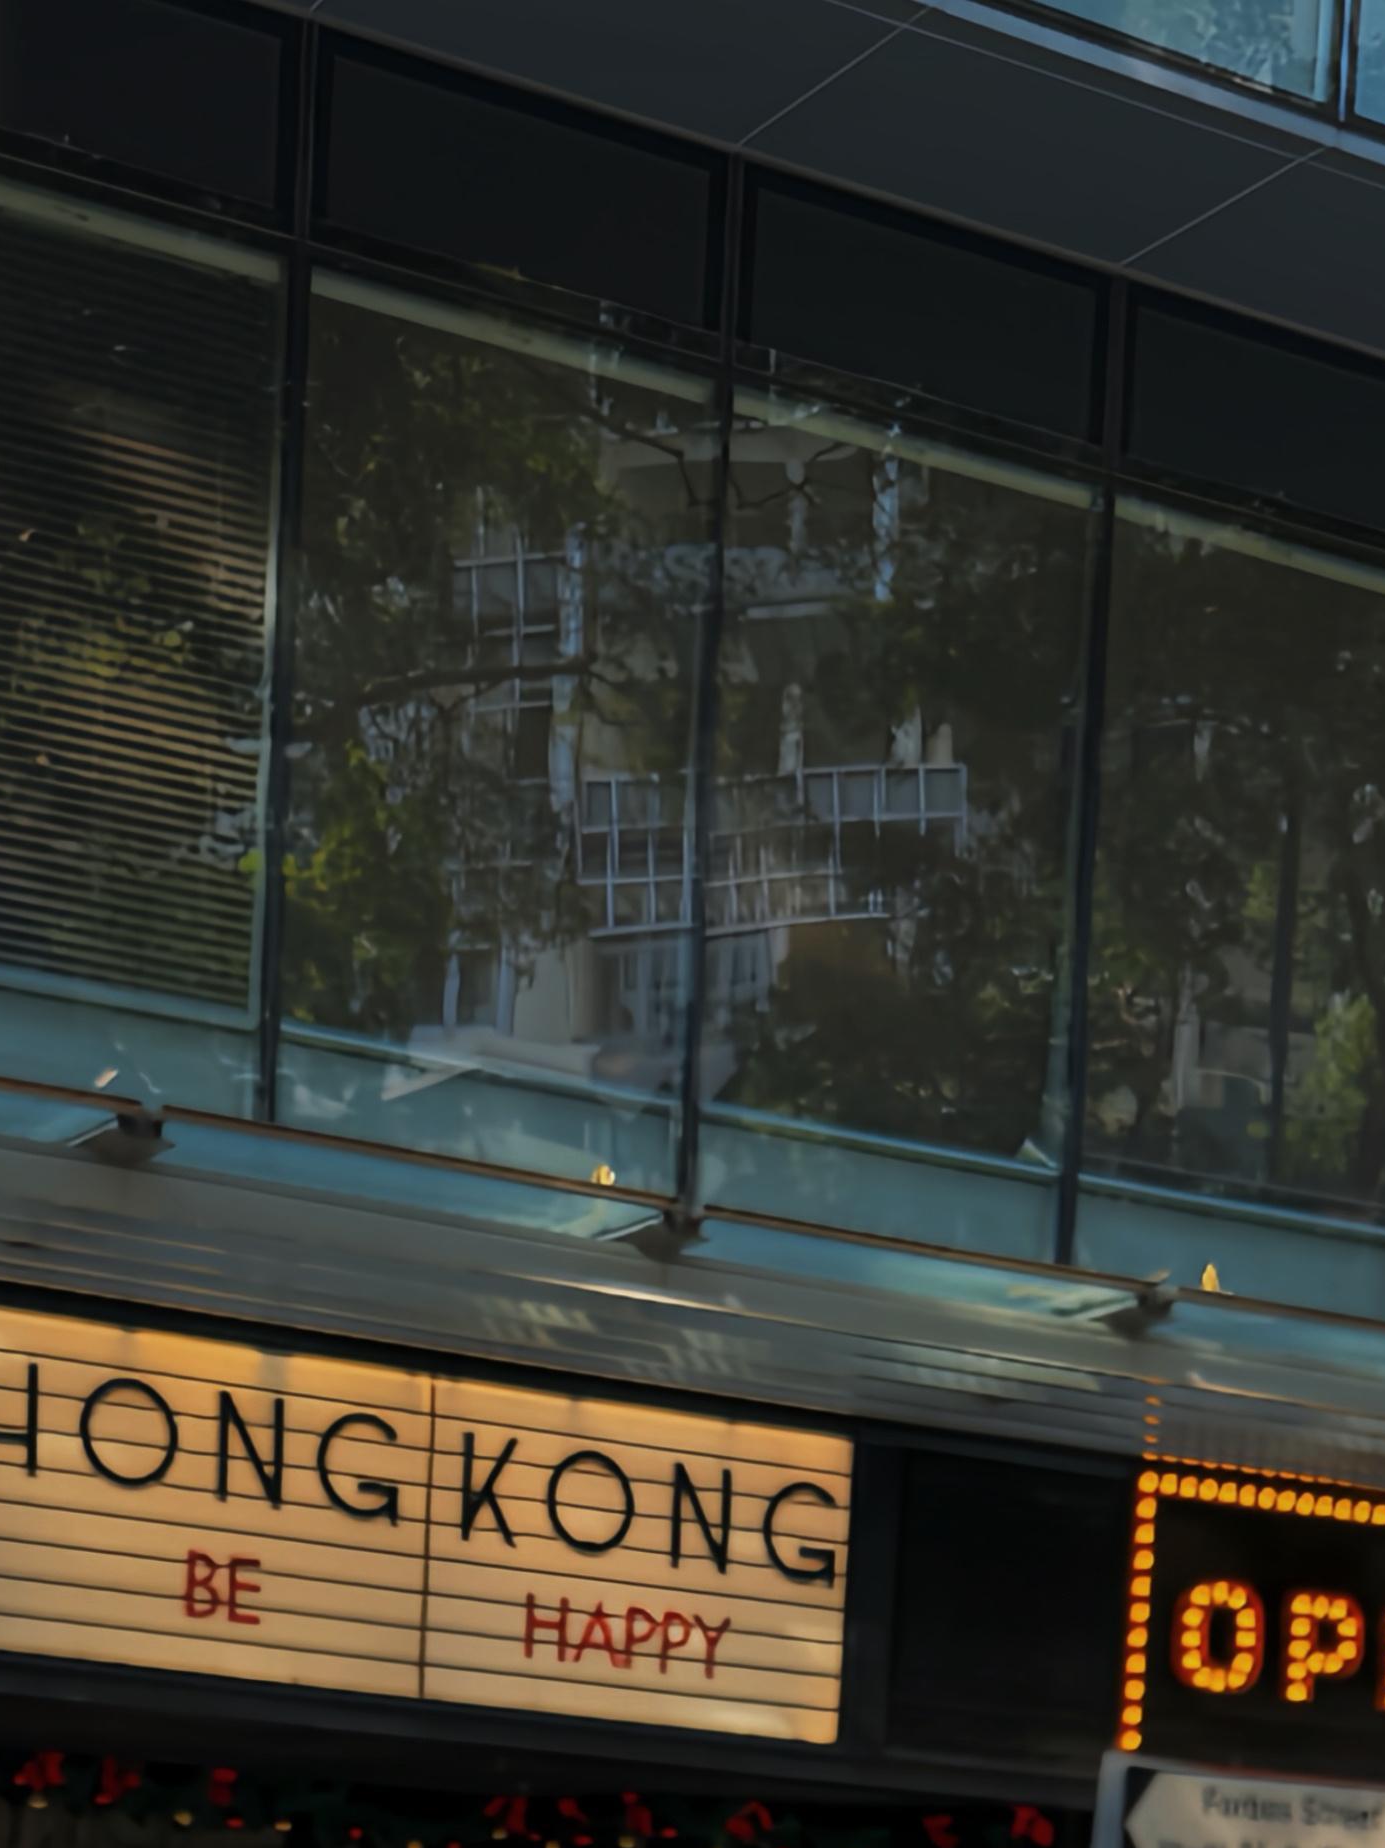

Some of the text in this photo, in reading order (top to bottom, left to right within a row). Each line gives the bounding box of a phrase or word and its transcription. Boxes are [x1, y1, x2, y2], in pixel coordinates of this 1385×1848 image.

[459, 1431, 837, 1588] KONG
[182, 1549, 732, 1680] BE HAPPY
